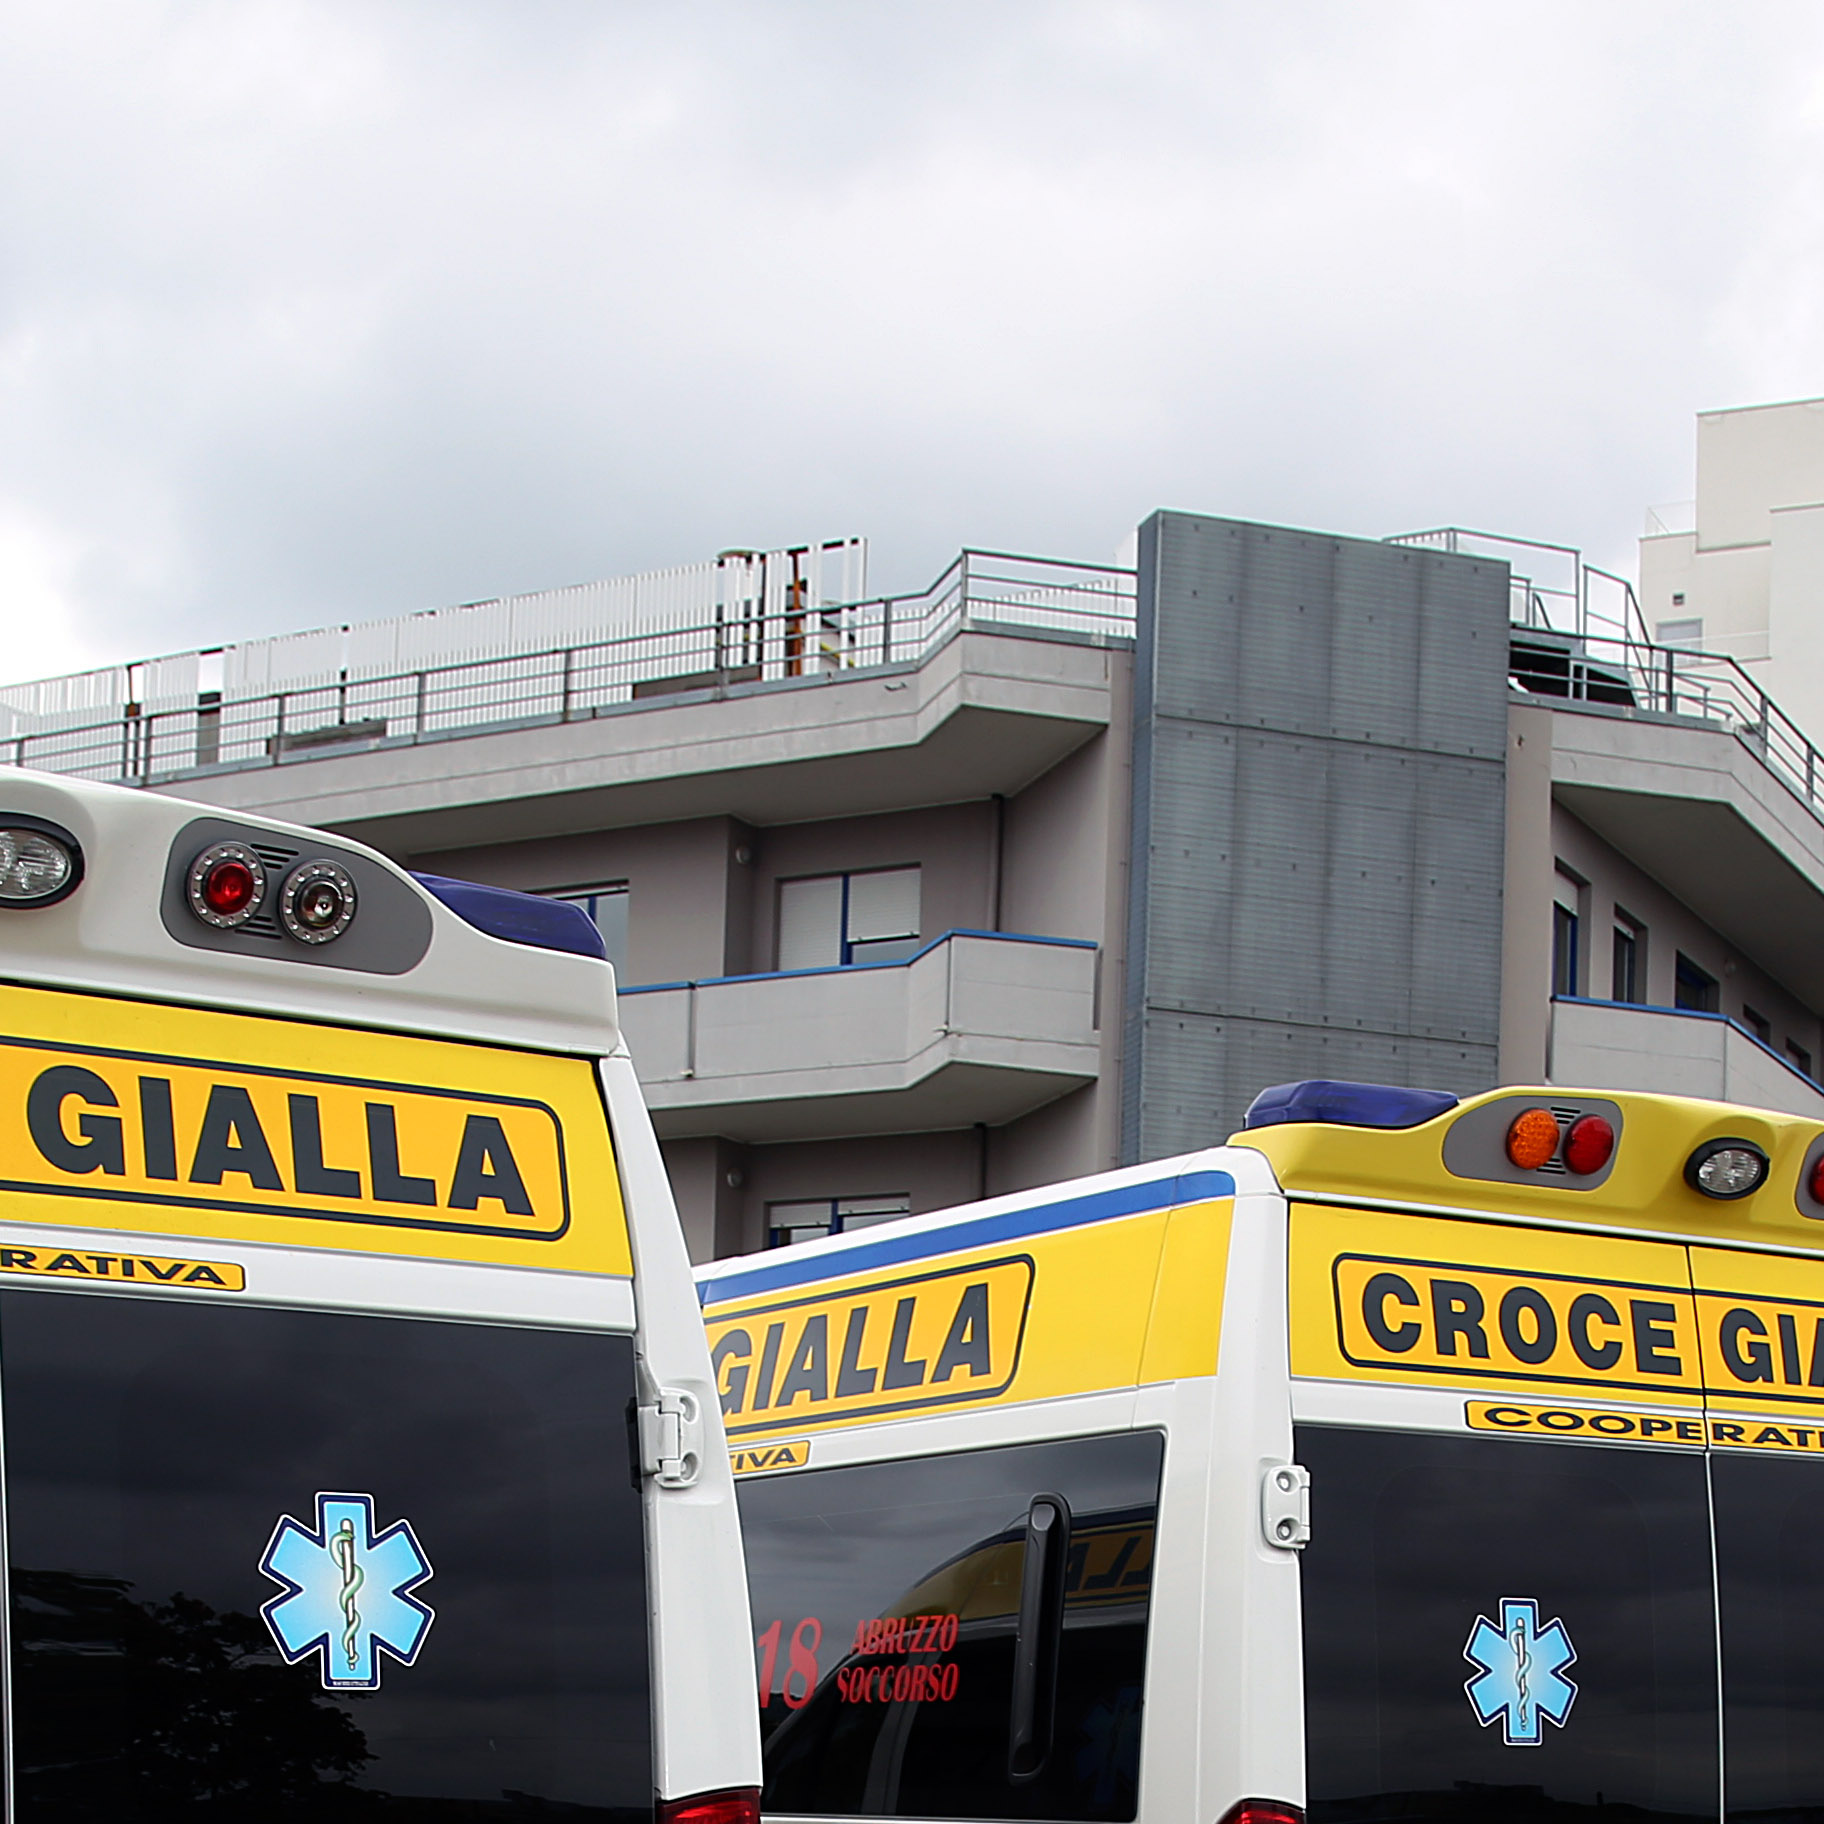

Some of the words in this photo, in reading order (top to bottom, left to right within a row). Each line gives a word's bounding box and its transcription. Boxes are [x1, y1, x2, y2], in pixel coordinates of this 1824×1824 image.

[26, 1065, 537, 1217] GIALLA
[711, 1282, 991, 1417] GIALLA
[1361, 1272, 1684, 1377] CROCE
[729, 1447, 796, 1470] IVA
[849, 1613, 960, 1656] ABRUZZO
[837, 1663, 960, 1703] SOCCORSO
